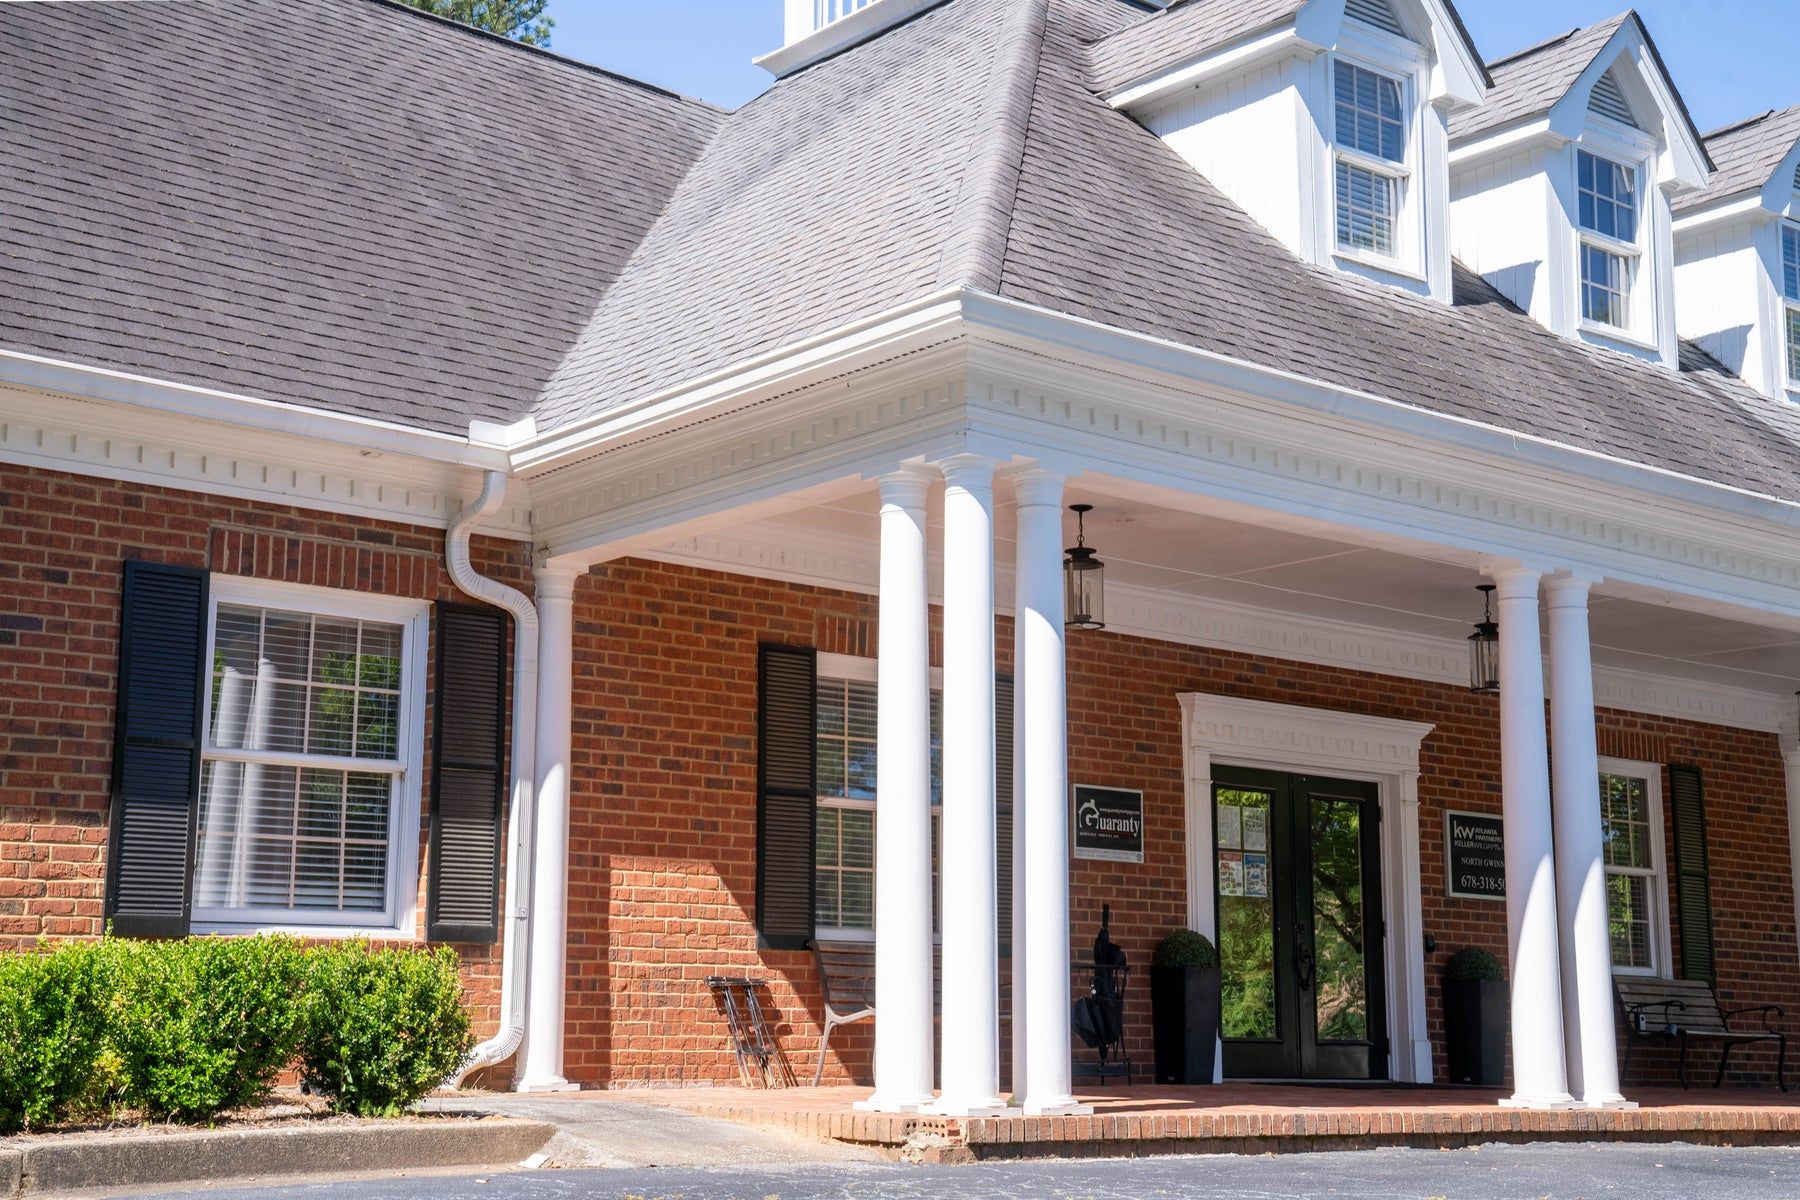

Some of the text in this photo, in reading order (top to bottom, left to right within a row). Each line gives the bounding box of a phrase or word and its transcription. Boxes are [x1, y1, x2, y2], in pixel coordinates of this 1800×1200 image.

[1078, 799, 1140, 838] Guaranty
[1453, 820, 1475, 840] kw
[1475, 827, 1498, 836] ATLANTA
[1475, 834, 1502, 844] PARTNERS
[1461, 856, 1483, 866] NORTH
